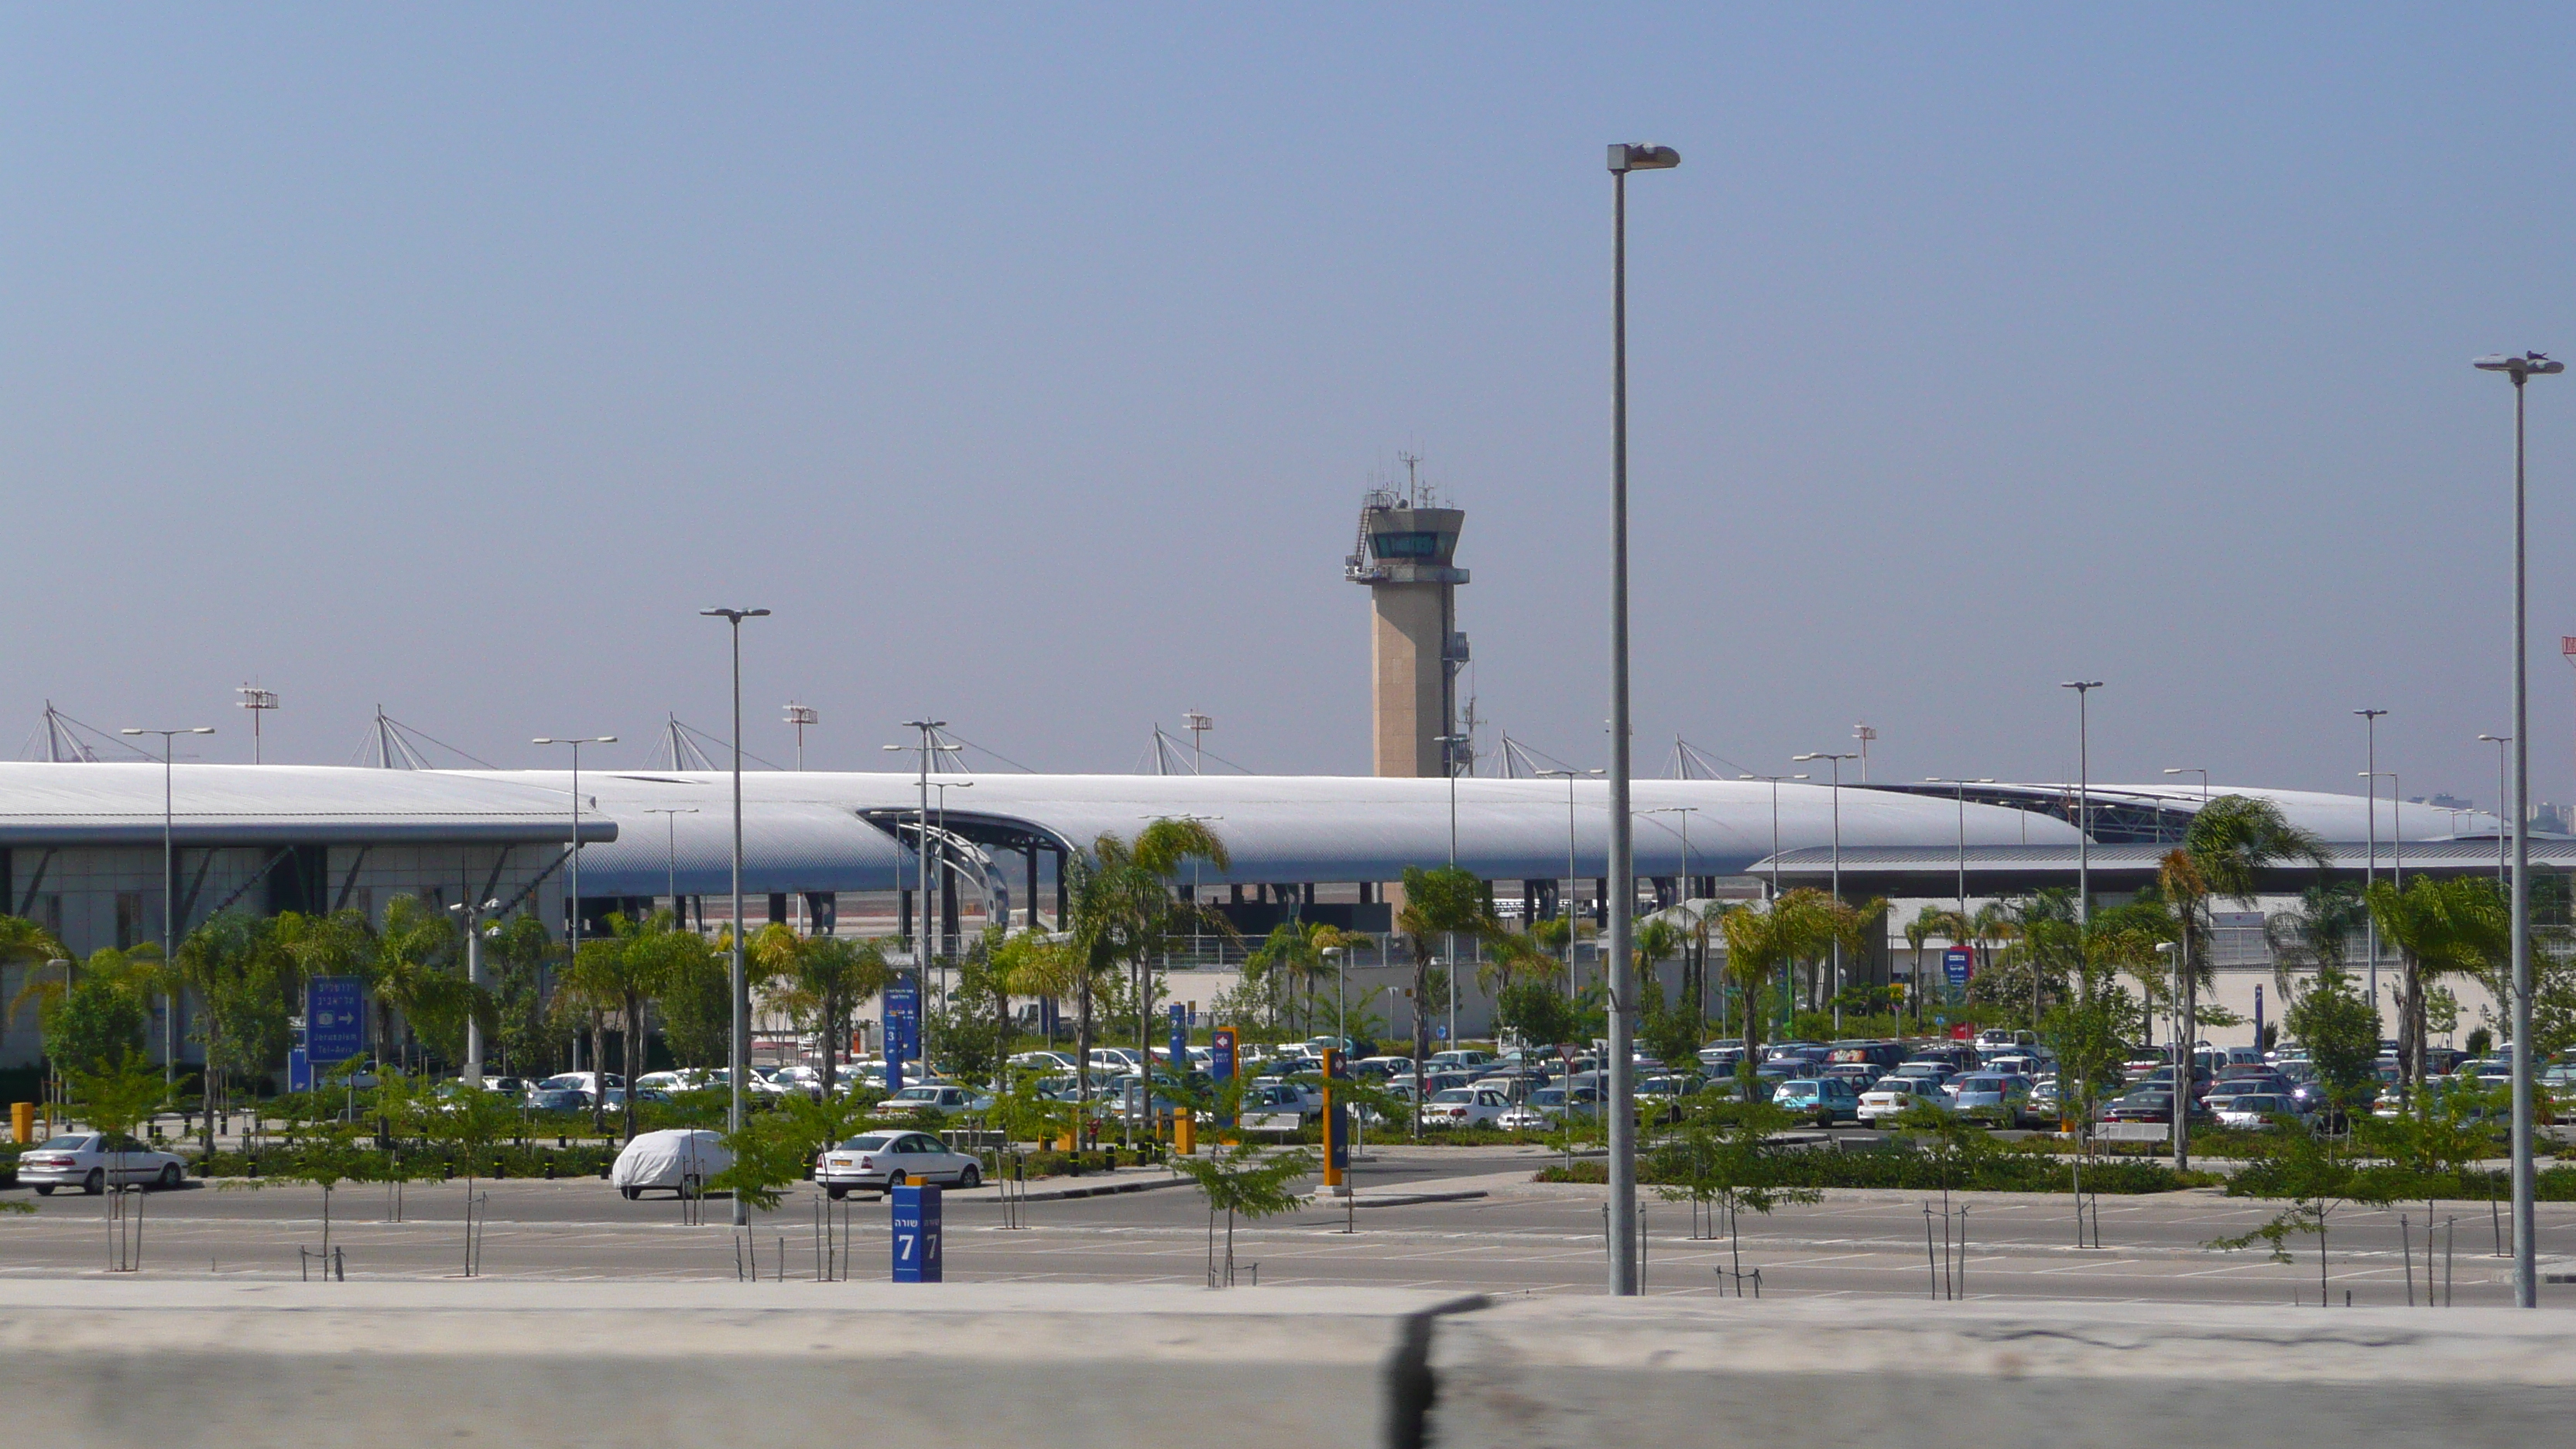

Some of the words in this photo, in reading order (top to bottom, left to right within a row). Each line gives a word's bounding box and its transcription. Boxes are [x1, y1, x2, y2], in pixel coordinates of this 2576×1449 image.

[319, 983, 354, 992] ירושלים
[888, 1031, 895, 1041] 3
[318, 1045, 353, 1053] Tel-Aviv
[895, 1219, 918, 1228] שורה
[899, 1235, 914, 1260] 7
[927, 1234, 937, 1259] 7
